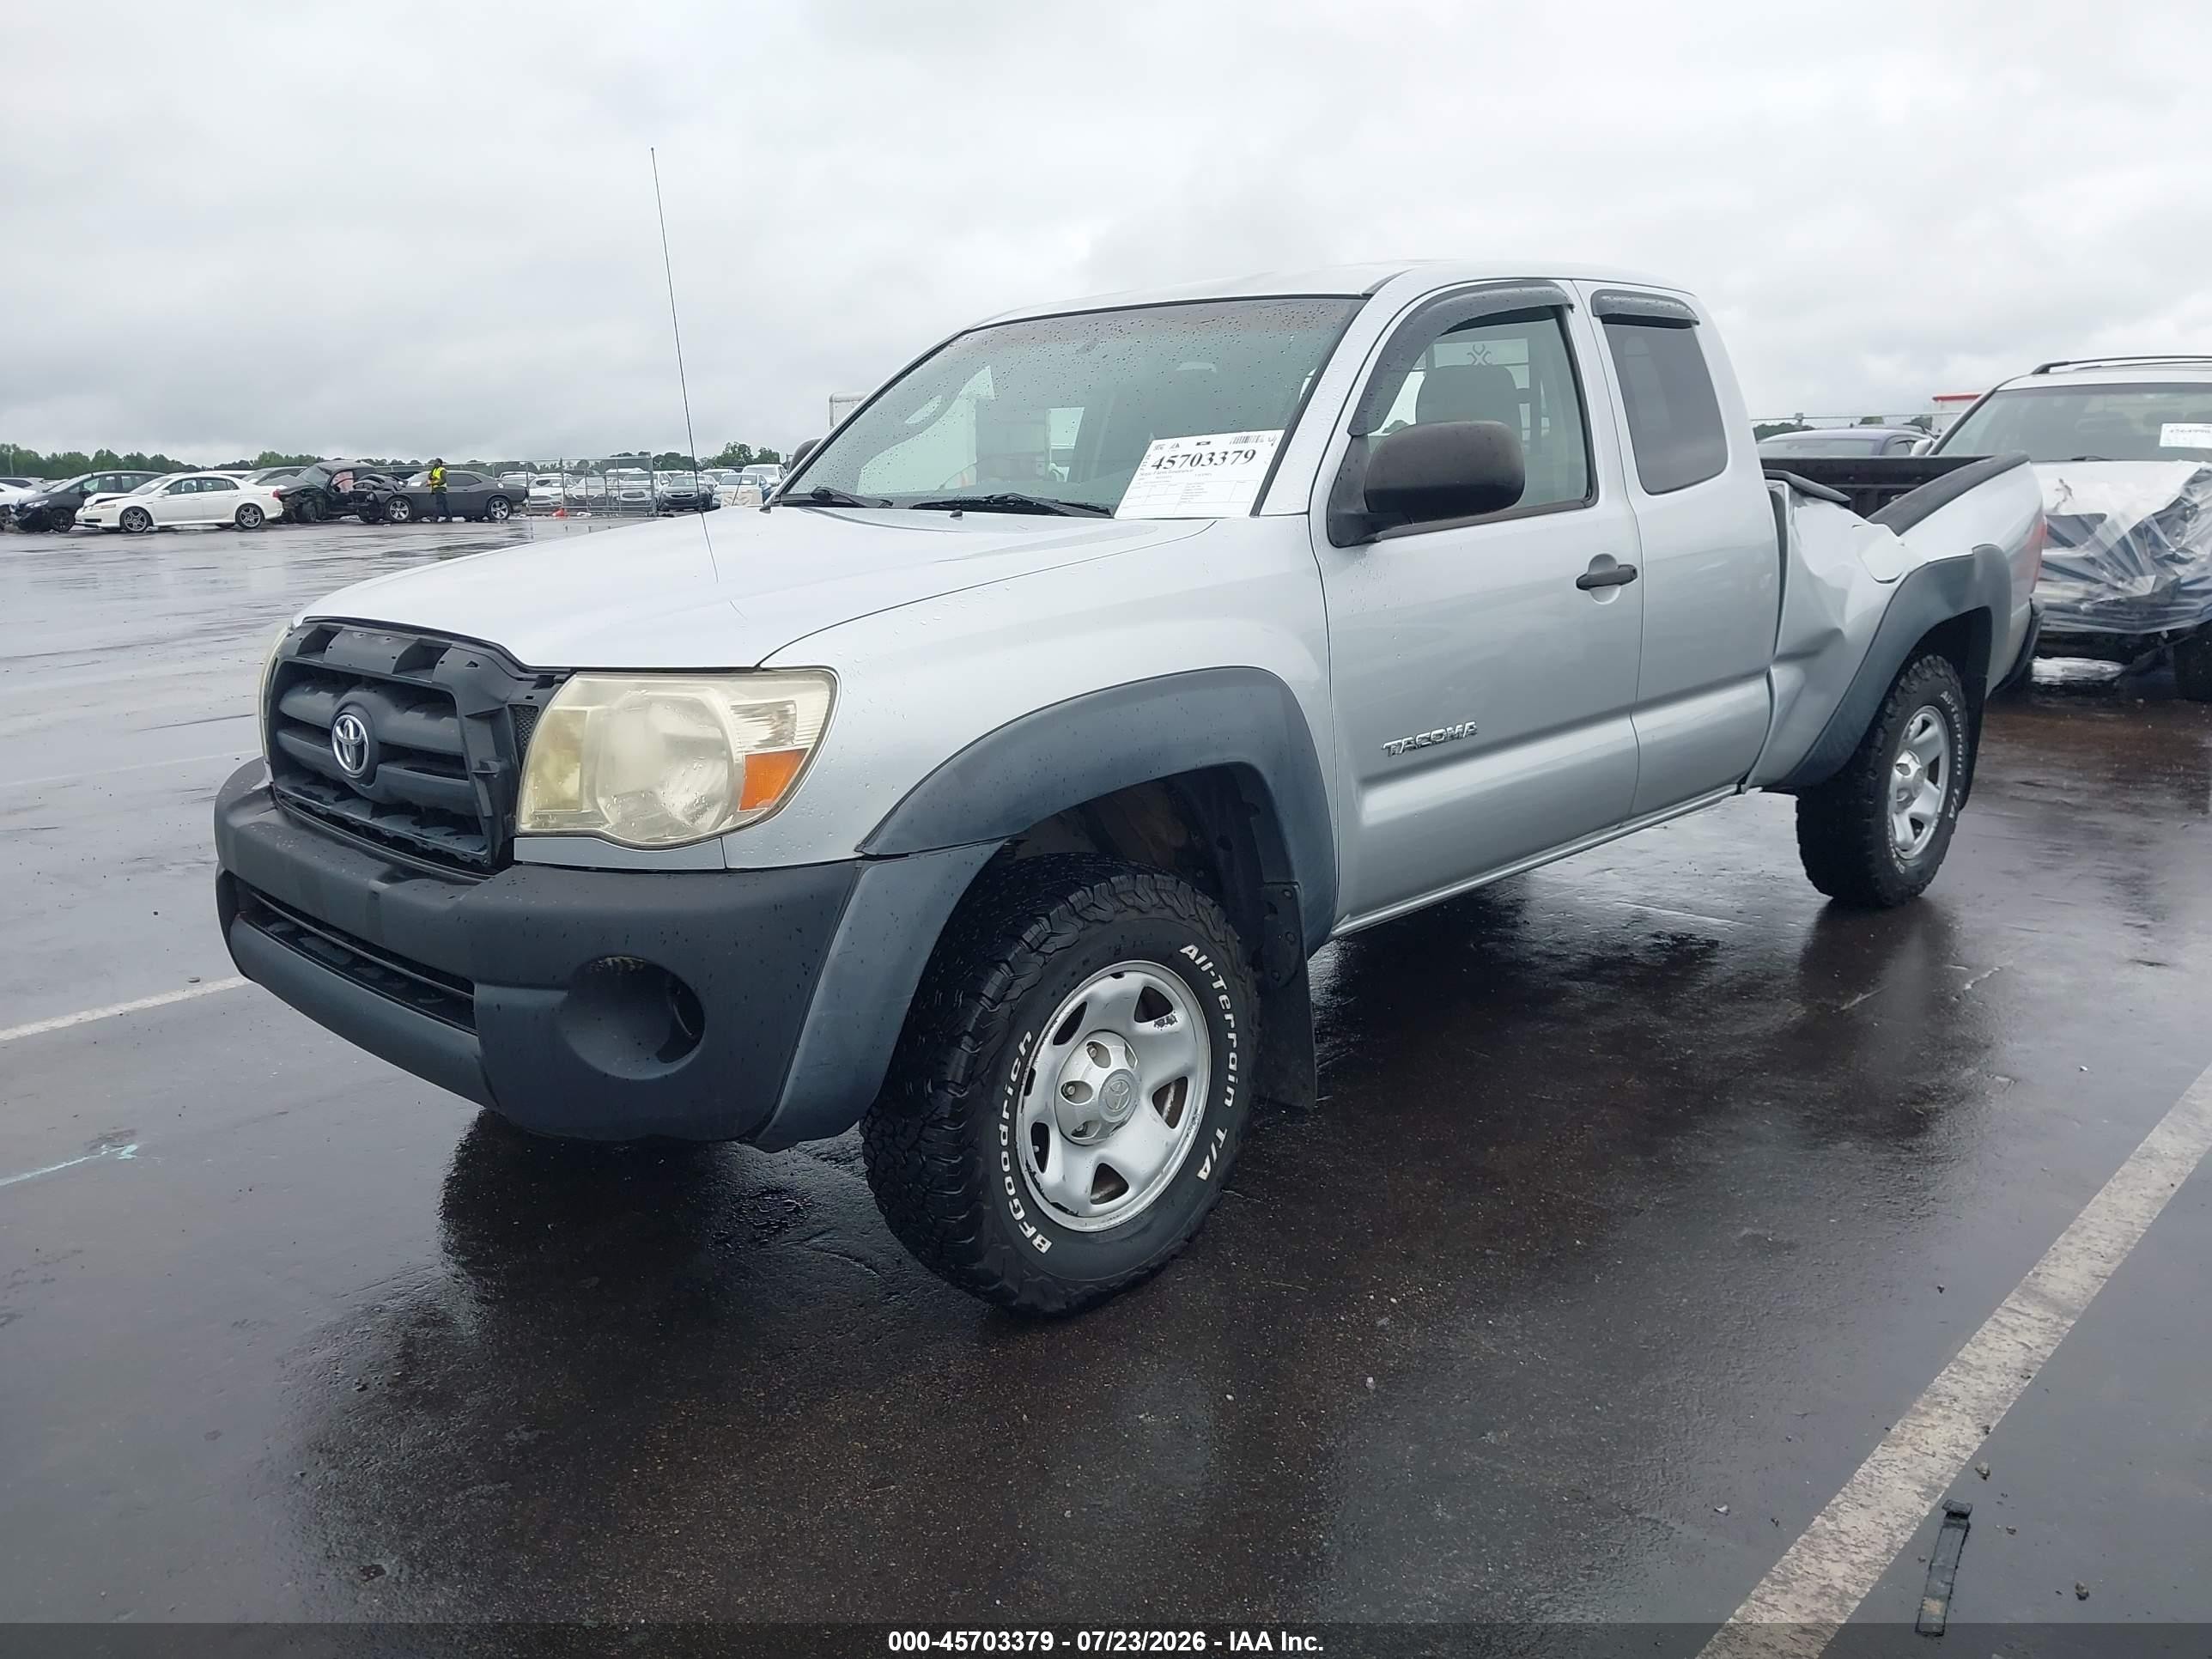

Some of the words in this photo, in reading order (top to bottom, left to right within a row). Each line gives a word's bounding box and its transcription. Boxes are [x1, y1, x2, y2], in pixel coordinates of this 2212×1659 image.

[1152, 449, 1256, 471] 45703379
[1381, 720, 1478, 757] TACOMA
[1179, 945, 1239, 1108] All-Terrain
[999, 1031, 1053, 1255] BFGoodrich
[1197, 1127, 1229, 1182] T/A
